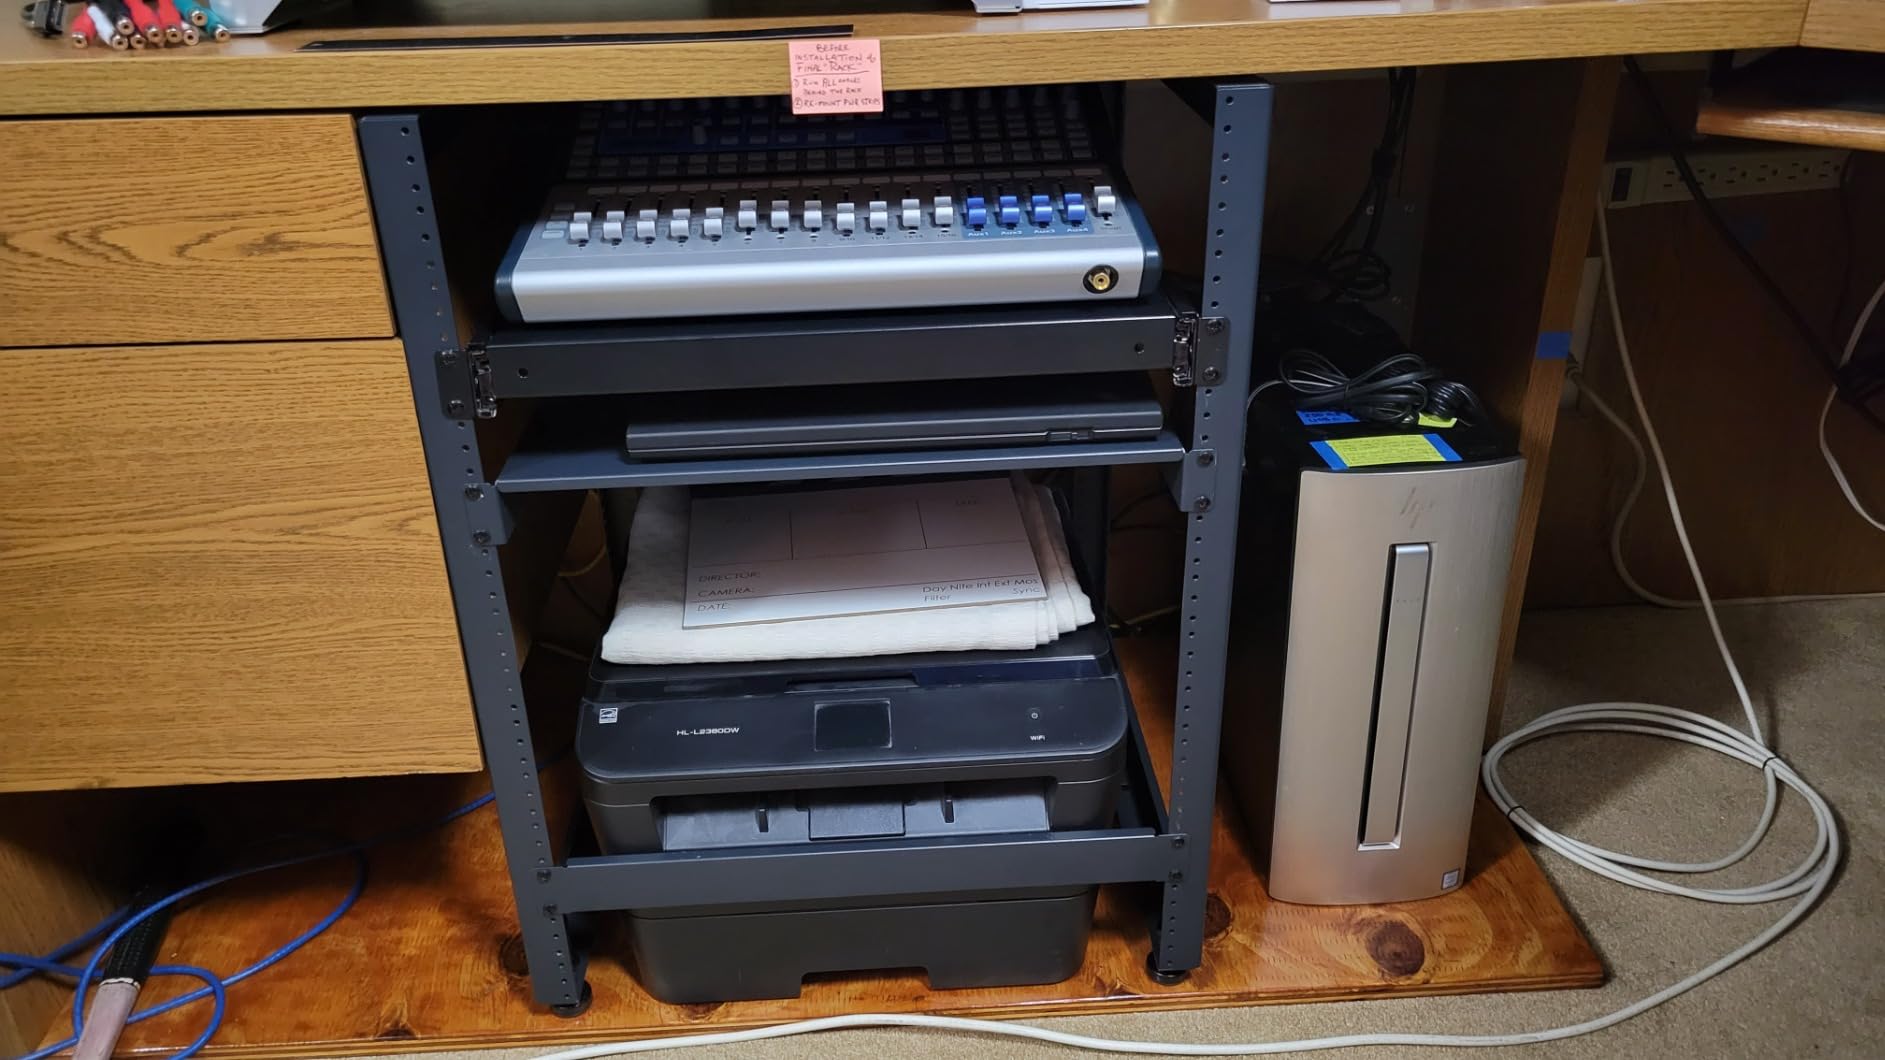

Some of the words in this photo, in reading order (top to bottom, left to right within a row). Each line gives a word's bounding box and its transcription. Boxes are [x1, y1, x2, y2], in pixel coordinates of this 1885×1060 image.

[816, 43, 849, 52] BEFORE
[794, 53, 862, 61] INSTALLATION
[796, 62, 822, 72] FINAL
[822, 78, 837, 87] ALL
[977, 581, 991, 589] Int
[1012, 587, 1040, 595] Sync
[924, 594, 951, 602] Filter
